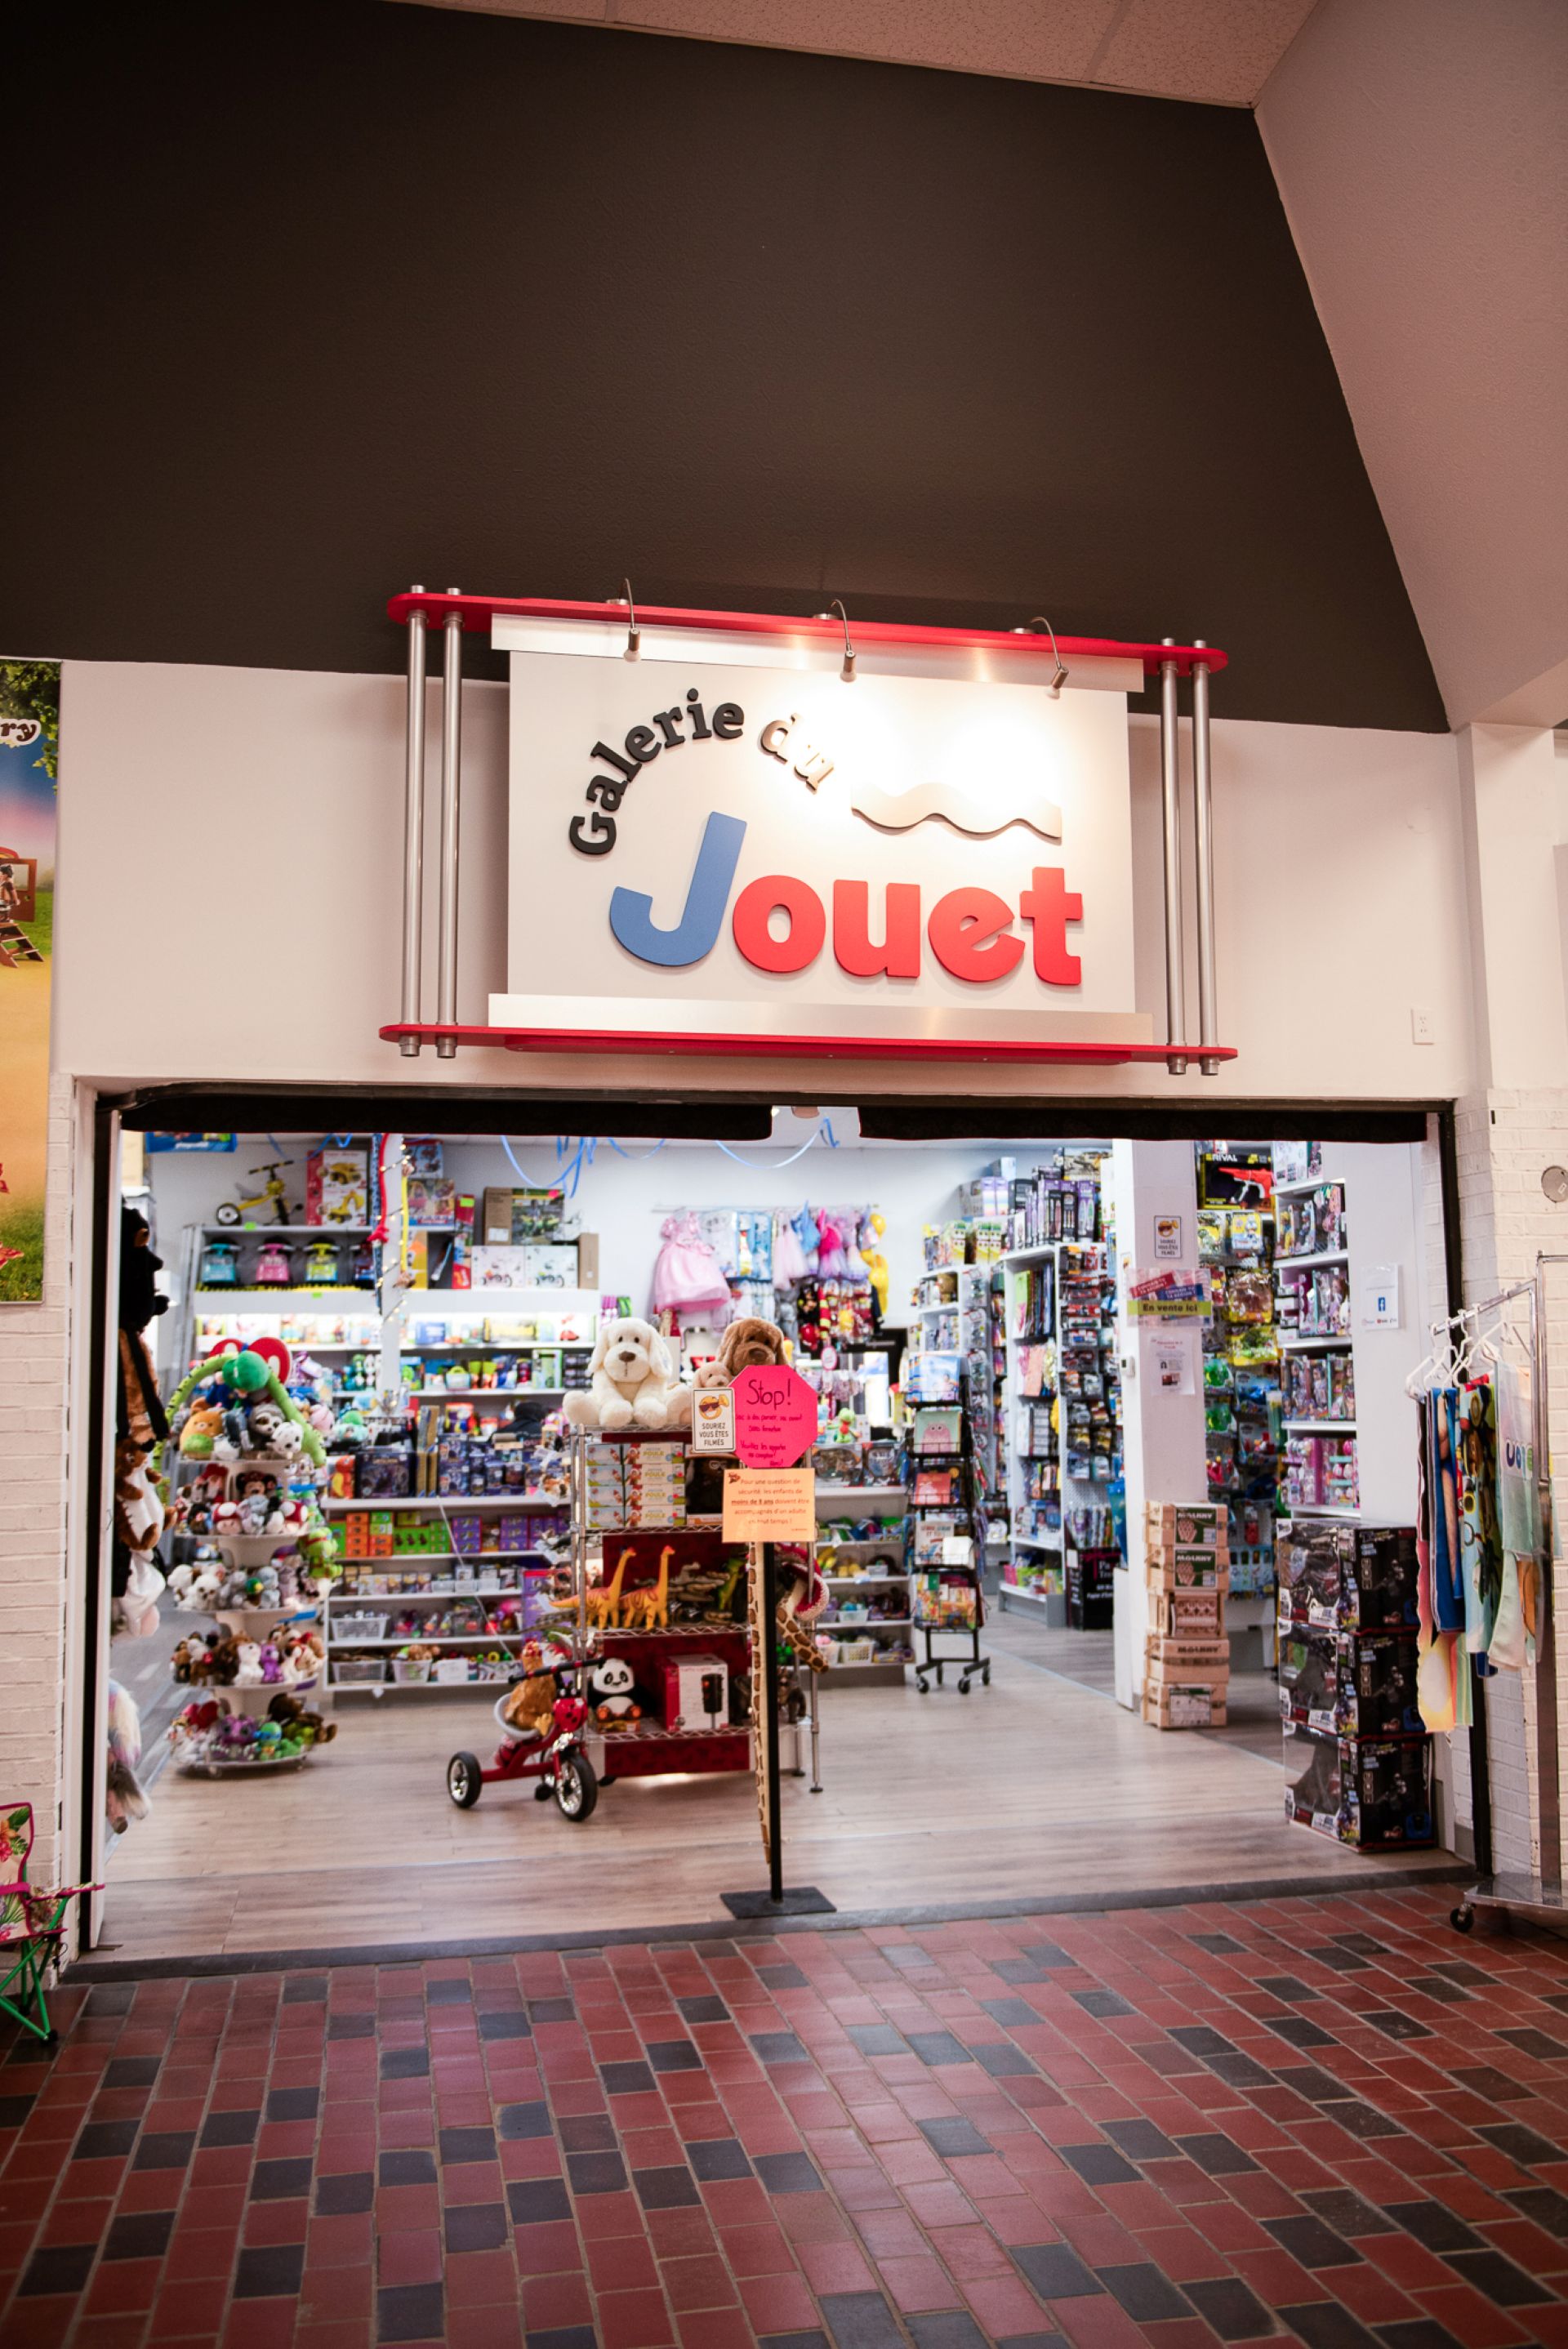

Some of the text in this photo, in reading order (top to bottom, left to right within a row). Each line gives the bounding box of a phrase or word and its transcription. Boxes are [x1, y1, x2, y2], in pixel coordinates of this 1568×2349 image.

[569, 688, 835, 856] Galerie du
[609, 810, 1084, 986] Jouet
[1143, 1303, 1155, 1312] En
[1157, 1304, 1183, 1312] vente
[715, 1429, 728, 1437] ÊTES
[704, 1438, 724, 1446] FILMÉS
